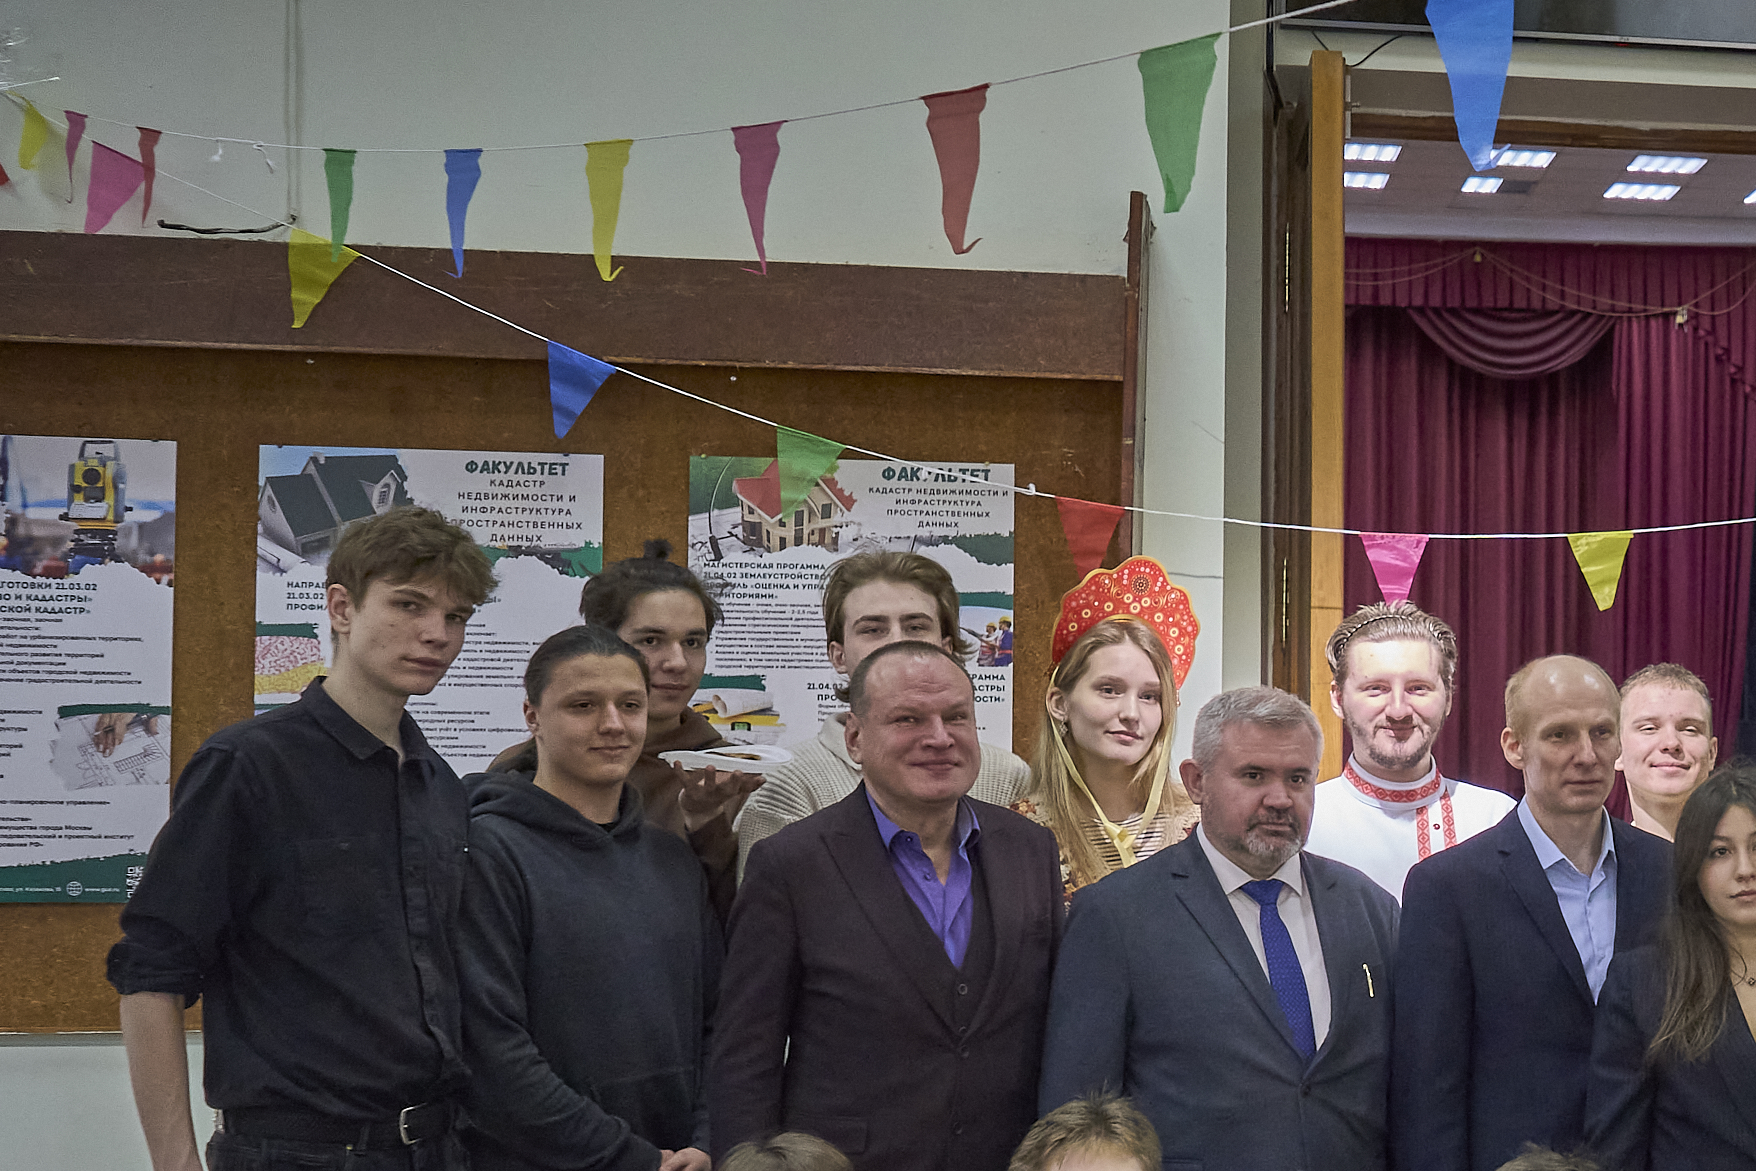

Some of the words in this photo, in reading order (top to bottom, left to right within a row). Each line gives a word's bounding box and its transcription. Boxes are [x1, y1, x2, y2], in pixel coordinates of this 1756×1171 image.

[465, 459, 570, 477] ФАКУЛЬТЕТ
[489, 479, 546, 489] КАДАСТР
[457, 491, 564, 503] НЕДВИЖИМОСТИ
[570, 494, 577, 503] И
[868, 487, 913, 496] КАДАСТР
[916, 487, 998, 498] НЕДВИЖИМОСТИ
[1002, 490, 1009, 498] И
[895, 498, 982, 508] ИНФРАСТРУКТУРА
[461, 505, 572, 517] ИНФРАСТРУКТУРА
[887, 508, 991, 518] ПРОСТРАНСТВЕННЫХ
[917, 519, 959, 530] ДАННЫХ
[490, 533, 543, 544] ДАННЫХ
[703, 562, 774, 570] МАГИСТЕРСКАЯ
[55, 582, 98, 591] 21.03.02
[14, 593, 22, 601] И
[26, 594, 93, 603] КАДАСТРЫ»
[287, 592, 325, 601] 21.03.02
[35, 606, 91, 615] КАДАСТР»
